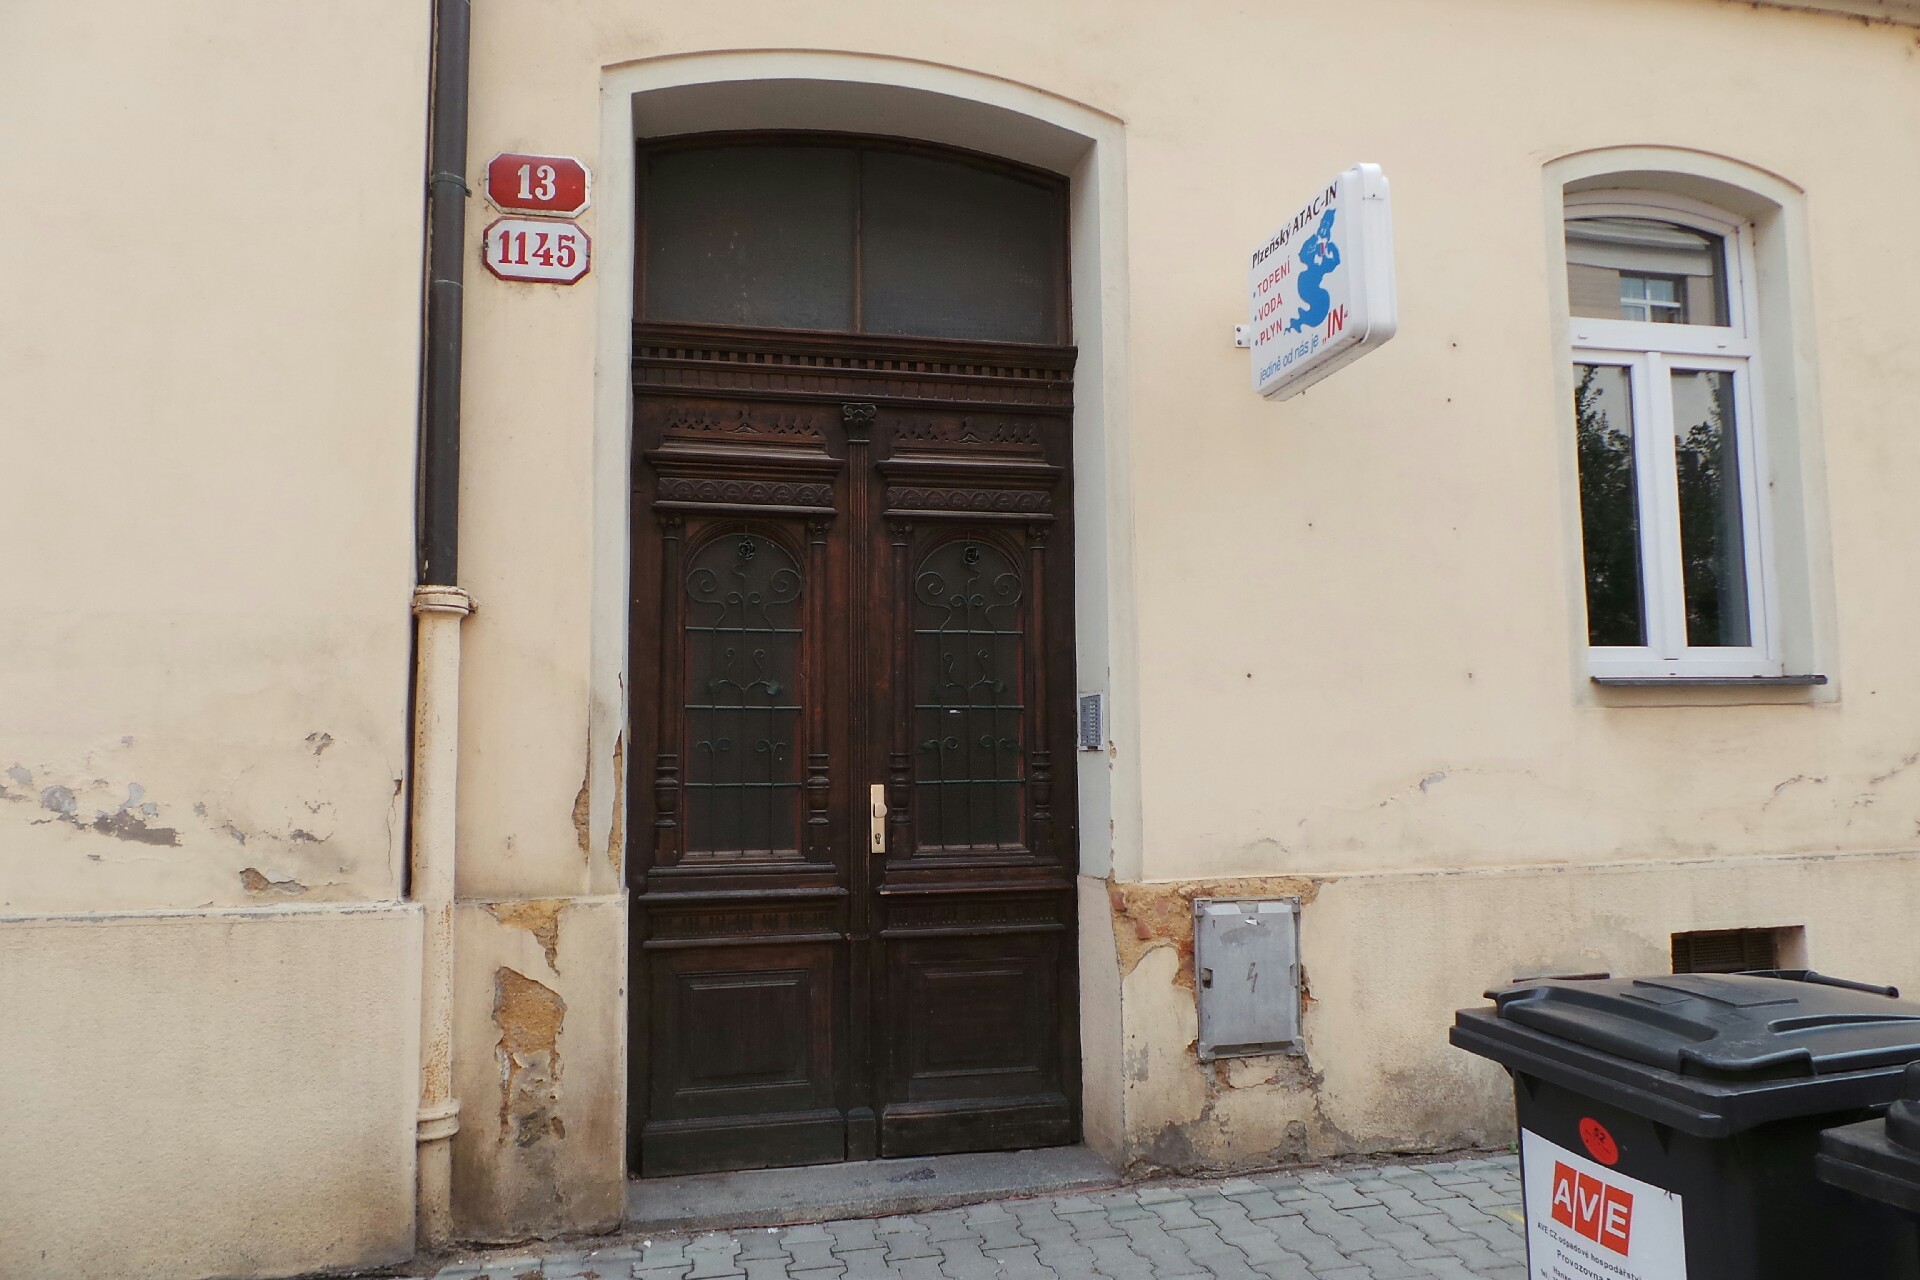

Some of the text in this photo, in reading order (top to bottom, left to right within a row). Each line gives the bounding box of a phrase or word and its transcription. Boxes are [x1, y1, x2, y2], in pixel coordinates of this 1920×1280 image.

[517, 164, 556, 201] 13
[1251, 180, 1338, 271] Plzeňský ATAC-IN
[498, 229, 576, 268] 1145
[1257, 255, 1290, 297] TOPENÍ
[1258, 293, 1283, 321] VODA
[1260, 317, 1283, 347] PLYN
[1282, 346, 1293, 368] od
[1294, 335, 1309, 361] nás
[1311, 333, 1319, 354] je
[1553, 1178, 1628, 1239] AVE
[1537, 1222, 1549, 1234] AVE
[1549, 1229, 1558, 1240] CZ
[1558, 1236, 1589, 1259] odpadové
